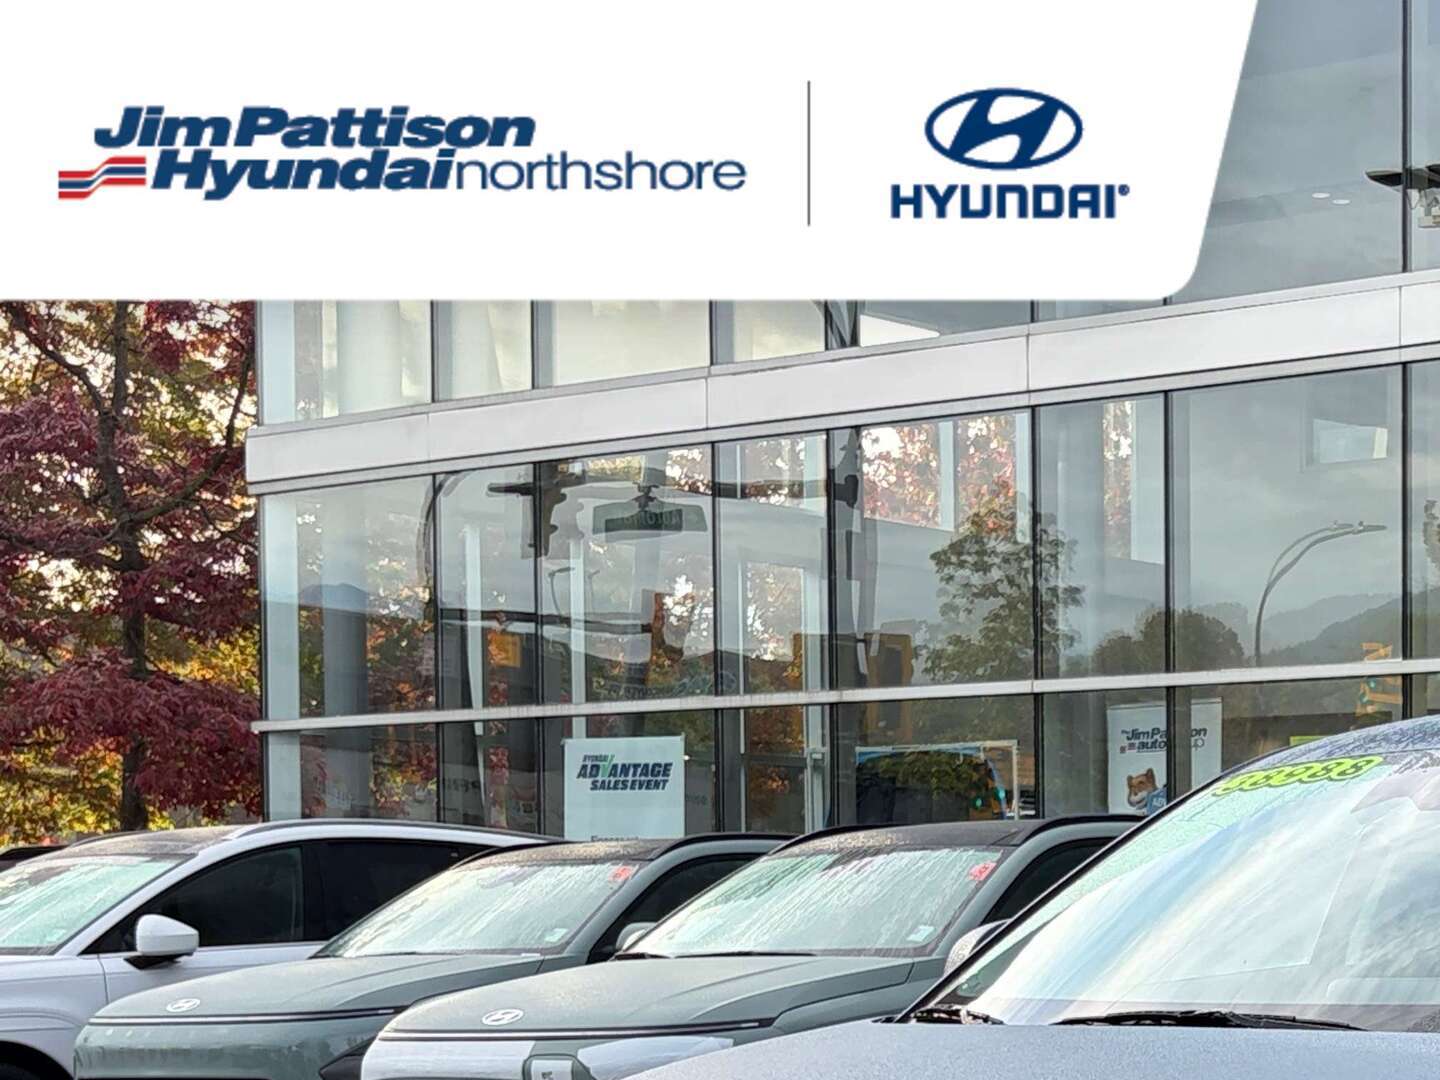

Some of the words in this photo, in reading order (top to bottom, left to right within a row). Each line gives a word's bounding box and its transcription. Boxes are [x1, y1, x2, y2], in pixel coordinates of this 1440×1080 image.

[576, 760, 673, 779] ADVANTAGE
[590, 779, 630, 791] SALES
[629, 779, 669, 791] EVENT
